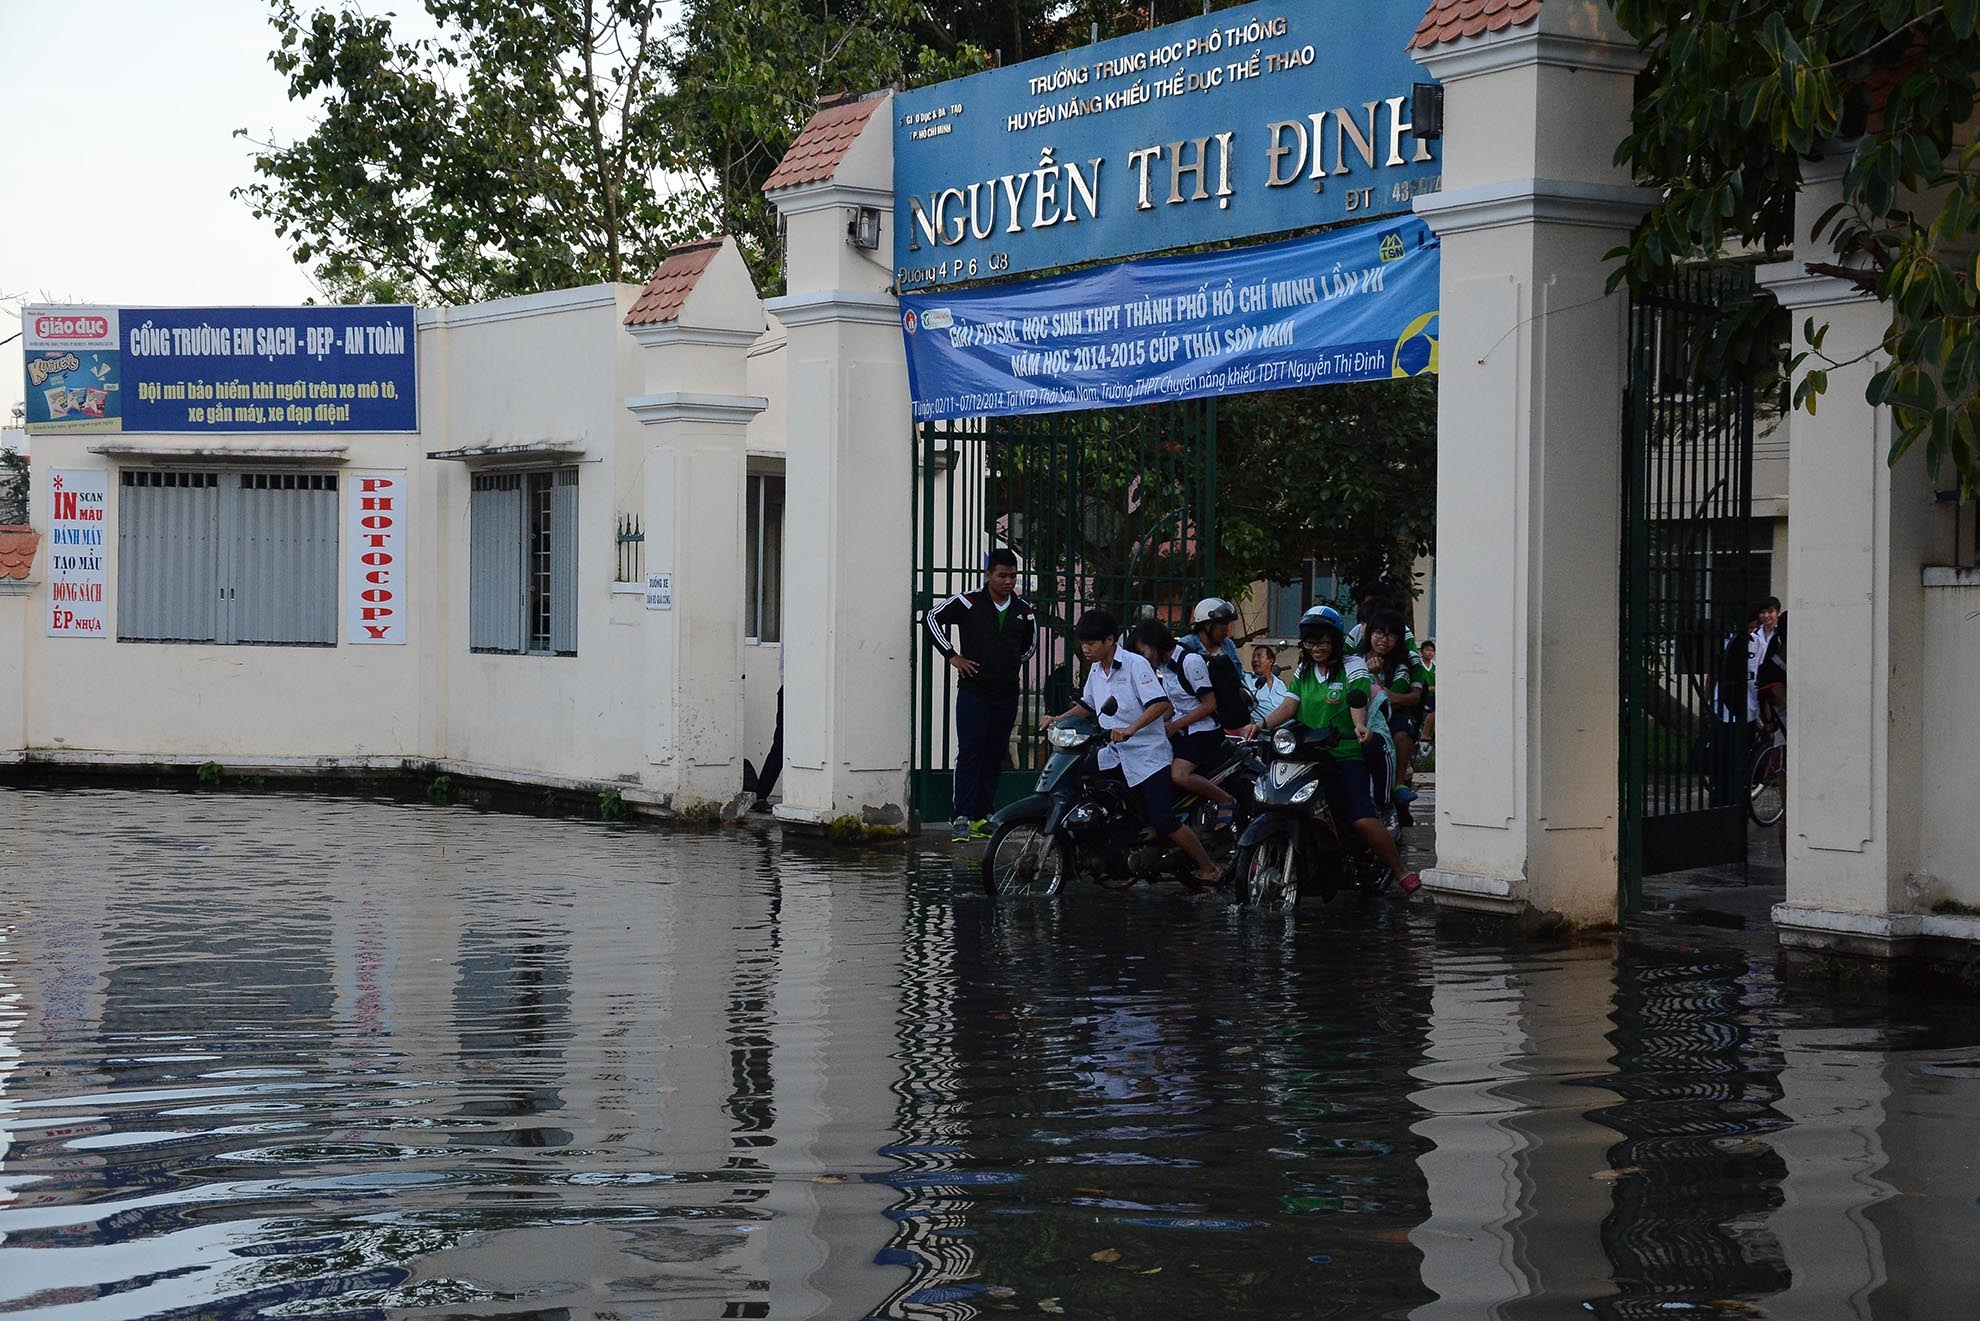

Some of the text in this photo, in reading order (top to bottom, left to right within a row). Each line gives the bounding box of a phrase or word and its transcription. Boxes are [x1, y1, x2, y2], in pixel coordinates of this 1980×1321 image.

[1028, 66, 1088, 96] TRƯỜNG
[1094, 52, 1147, 80] TRUNG
[1150, 42, 1182, 68] HỌC
[1225, 16, 1287, 48] THÔNG
[1058, 96, 1102, 120] NĂNG
[1106, 78, 1150, 111] KHIẾU
[1154, 67, 1184, 98] THỂ
[1188, 67, 1224, 94] DỤC
[1227, 49, 1261, 82] THỂ
[1265, 45, 1315, 73] THAO
[950, 104, 963, 117] TẠO
[937, 124, 952, 136] MINH
[908, 96, 1432, 250] NGUYỄN THỊ ĐỊNH
[1345, 186, 1374, 210] ĐT
[940, 260, 947, 278] 4
[954, 259, 963, 277] P
[968, 258, 978, 276] 6
[988, 252, 1008, 270] Q8
[1380, 246, 1404, 260] TSN
[949, 318, 973, 348] GIẢI
[974, 320, 1020, 346] FUTSAL
[1022, 315, 1048, 344] HỌC
[1052, 312, 1082, 338] SINH
[1086, 305, 1120, 332] THPT
[1124, 294, 1172, 328] THÀNH
[1176, 282, 1208, 320] PHỐ
[1212, 278, 1234, 316] HỒ
[1239, 277, 1267, 312] CHÍ
[1272, 277, 1318, 308] MINH
[1320, 262, 1358, 300] LẦN
[40, 318, 104, 337] giáo dục
[130, 320, 170, 356] CỔNG
[172, 322, 231, 356] TRƯỜNG
[234, 328, 254, 356] EM
[256, 326, 296, 362] SẠCH
[306, 326, 334, 362] ĐẸP
[344, 326, 364, 354] AN
[366, 320, 404, 354] TOÀN
[1011, 320, 1296, 378] NĂM HỌC 2014-2015 CÚP THÁI SƠN NAM
[138, 378, 398, 404] Đội mũ bảo hiểm khi ngồi trên xe mô tô,
[960, 392, 1003, 412] 07/12/2014
[1006, 390, 1018, 410] Tại
[1040, 388, 1058, 404] Thái
[1076, 384, 1100, 402] Nam,
[1101, 381, 1134, 402] Trường
[1136, 377, 1162, 396] THPT
[1160, 374, 1196, 396] Chuyên
[1199, 371, 1226, 392] năng
[1228, 362, 1256, 386] khiếu
[1258, 361, 1287, 382] TDTT
[1288, 354, 1330, 382] Nguyễn
[1334, 354, 1352, 376] Thị
[1354, 350, 1385, 376] Định
[188, 402, 350, 426] xe gắn máy, xe đạp điện!
[54, 492, 103, 520] IN SCAN
[54, 524, 103, 546] ĐÁNH MÁY
[53, 556, 76, 576] TẠO
[360, 478, 394, 639] PHOTOCOPY
[53, 578, 102, 602] ĐÓNG SÁCH
[52, 605, 102, 632] ÉP NHỰA
